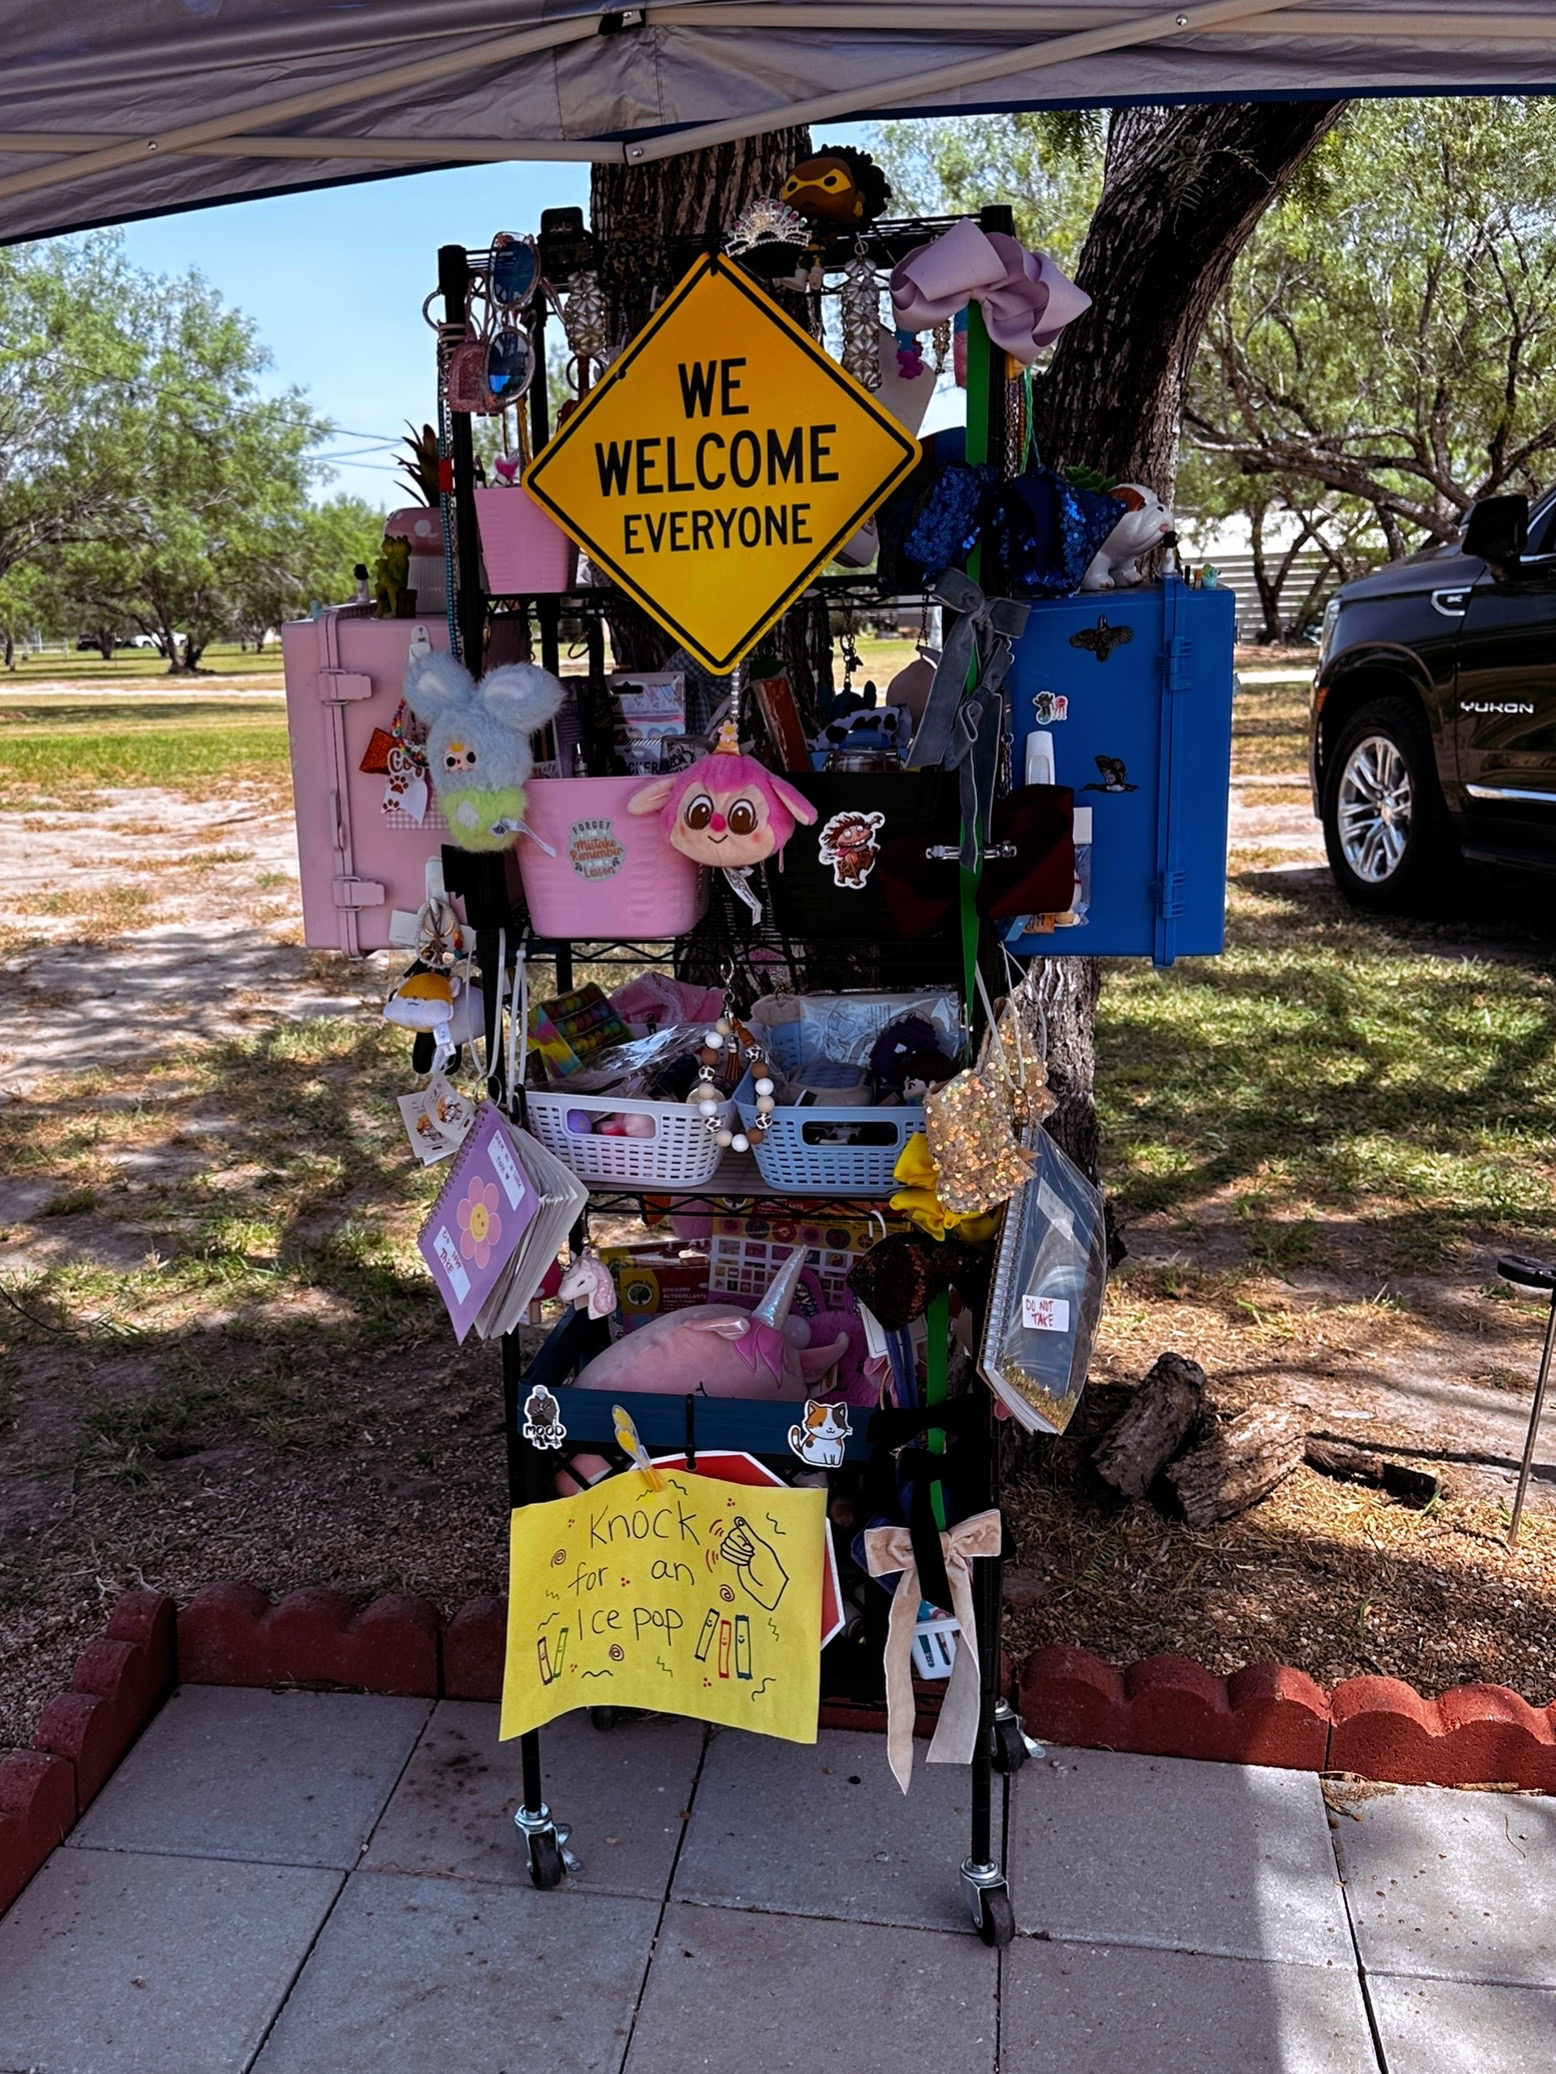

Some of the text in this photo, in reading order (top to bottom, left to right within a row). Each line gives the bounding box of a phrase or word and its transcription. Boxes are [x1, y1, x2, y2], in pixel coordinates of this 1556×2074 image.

[678, 357, 750, 419] WE
[594, 423, 840, 498] WELCOME
[624, 502, 813, 555] EVERYONE
[1460, 701, 1534, 714] YUKON
[571, 820, 611, 835] FORGET
[573, 837, 617, 852] Mistake
[569, 847, 625, 862] Remember
[583, 865, 616, 879] Lesson
[1026, 1298, 1055, 1312] DO NOT
[1031, 1313, 1054, 1328] TAKE
[525, 1424, 565, 1437] MOOD
[590, 1500, 701, 1549] Knock
[567, 1559, 695, 1597] for an
[578, 1607, 684, 1647] Ice pop
